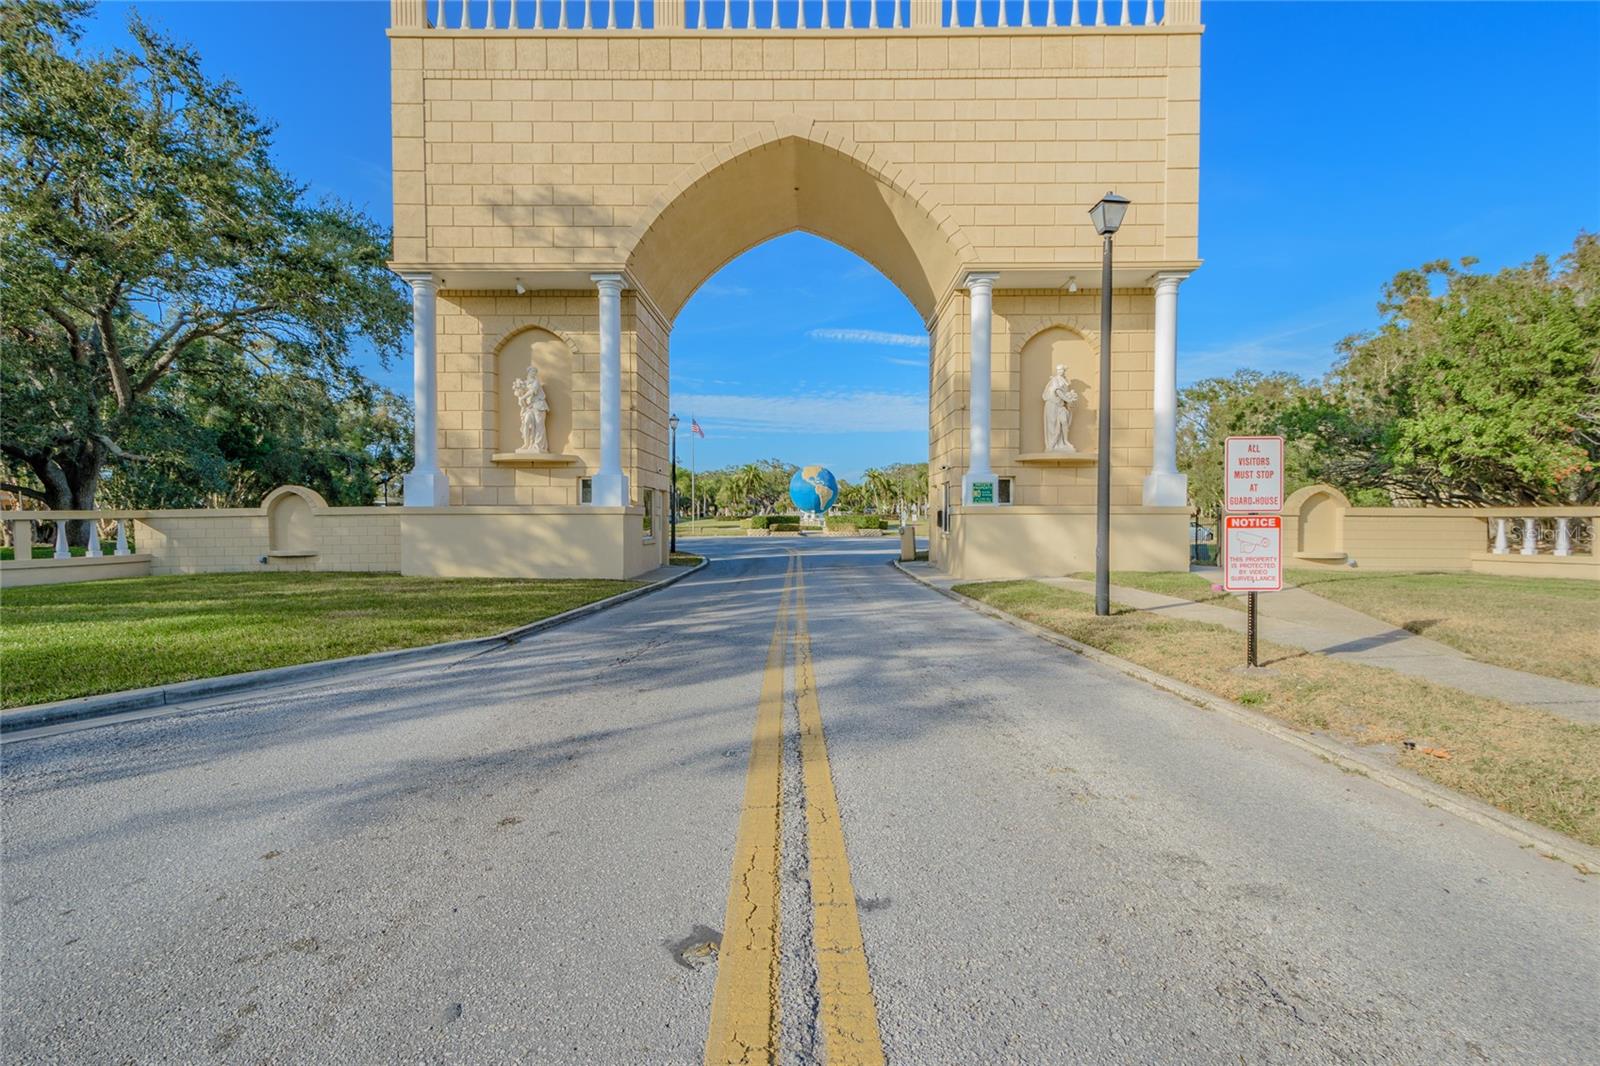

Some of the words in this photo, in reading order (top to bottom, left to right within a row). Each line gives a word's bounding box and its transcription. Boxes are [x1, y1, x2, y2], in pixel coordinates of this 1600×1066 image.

[1248, 444, 1261, 453] ALL
[1238, 457, 1270, 466] VISITORS
[1233, 470, 1253, 479] MUST
[1256, 470, 1275, 479] STOP
[1249, 483, 1258, 492] AT
[1231, 518, 1276, 527] NOTICE
